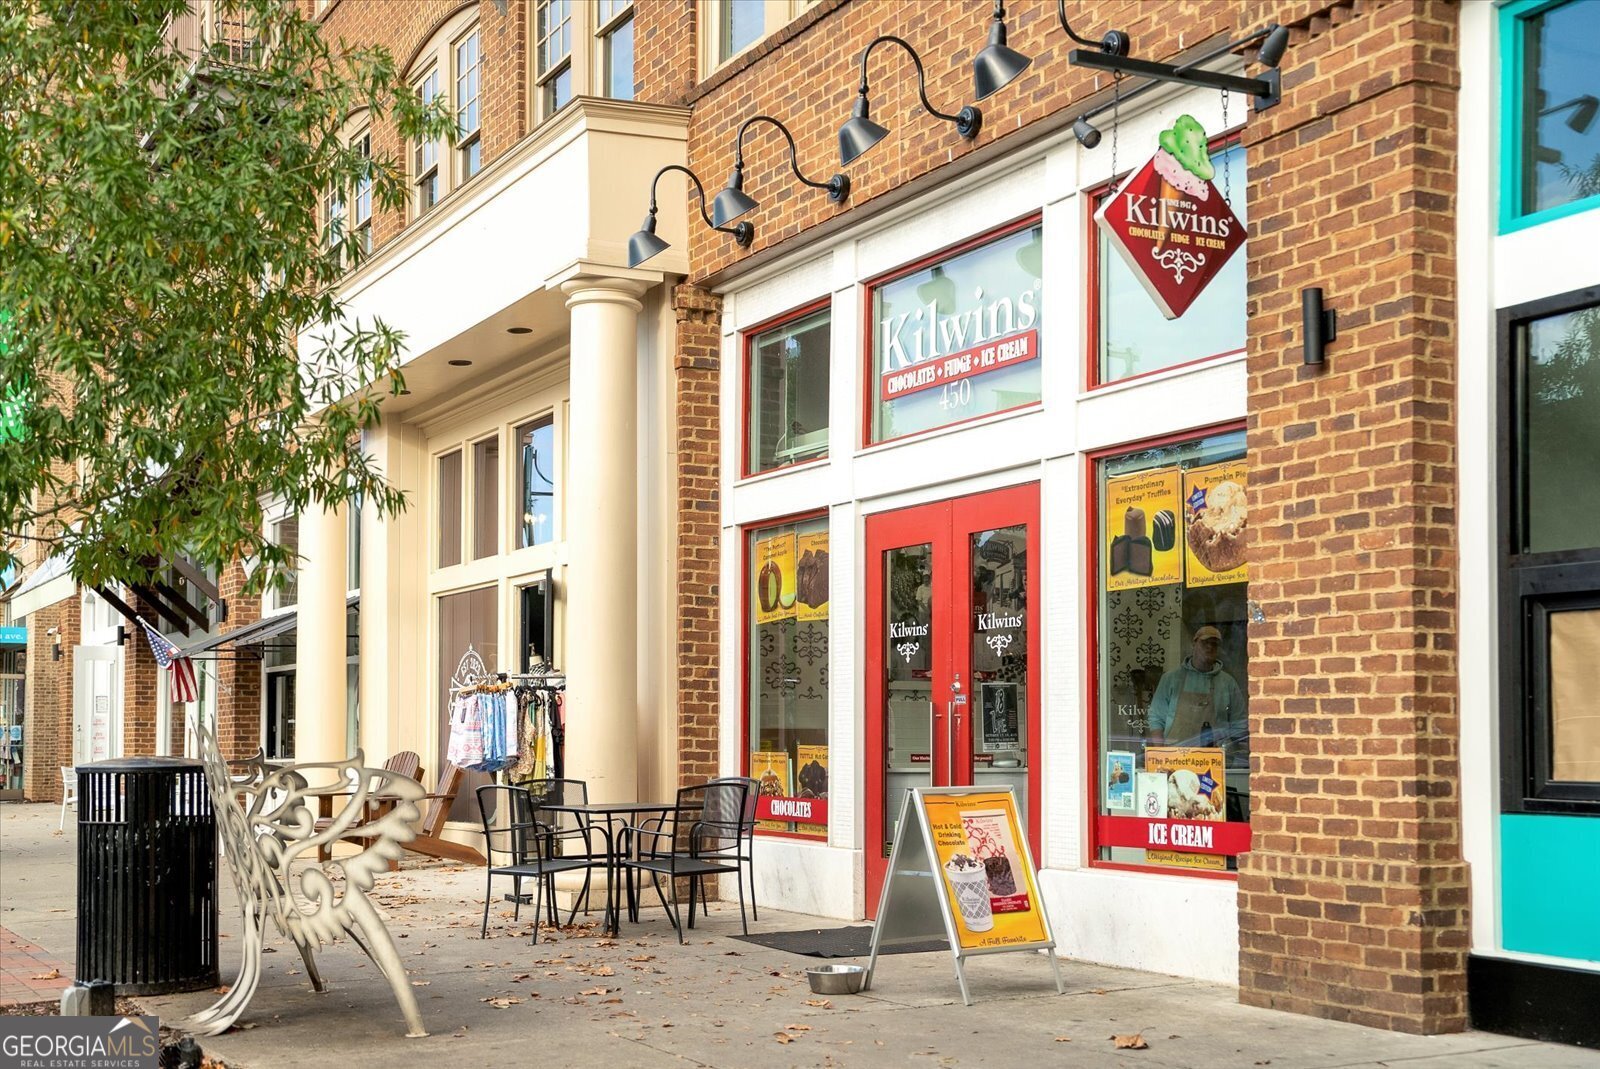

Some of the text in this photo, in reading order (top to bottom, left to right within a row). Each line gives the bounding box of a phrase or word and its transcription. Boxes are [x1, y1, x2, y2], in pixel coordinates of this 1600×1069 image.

[1124, 192, 1230, 238] Kilwins
[1129, 226, 1226, 250] CHOCOLATES FUDGE ICE CREAM
[881, 284, 1036, 374] Kilwins
[888, 336, 1029, 394] CHOCOLATES FUDGE ICE CREAM
[939, 379, 971, 410] 450
[1204, 470, 1246, 485] Pumpkin Pie
[1147, 488, 1172, 501] Truffles
[1192, 576, 1215, 585] Original
[890, 621, 928, 639] Kilwins
[978, 612, 1023, 631] Kilwins
[1118, 704, 1150, 716] Kilwi
[1191, 758, 1210, 768] Apple
[1211, 759, 1221, 767] Pie
[771, 799, 812, 818] CHOCOLATES
[938, 839, 966, 847] Chocolate
[1148, 823, 1213, 848] ICE CREAM
[1151, 852, 1173, 863] Original
